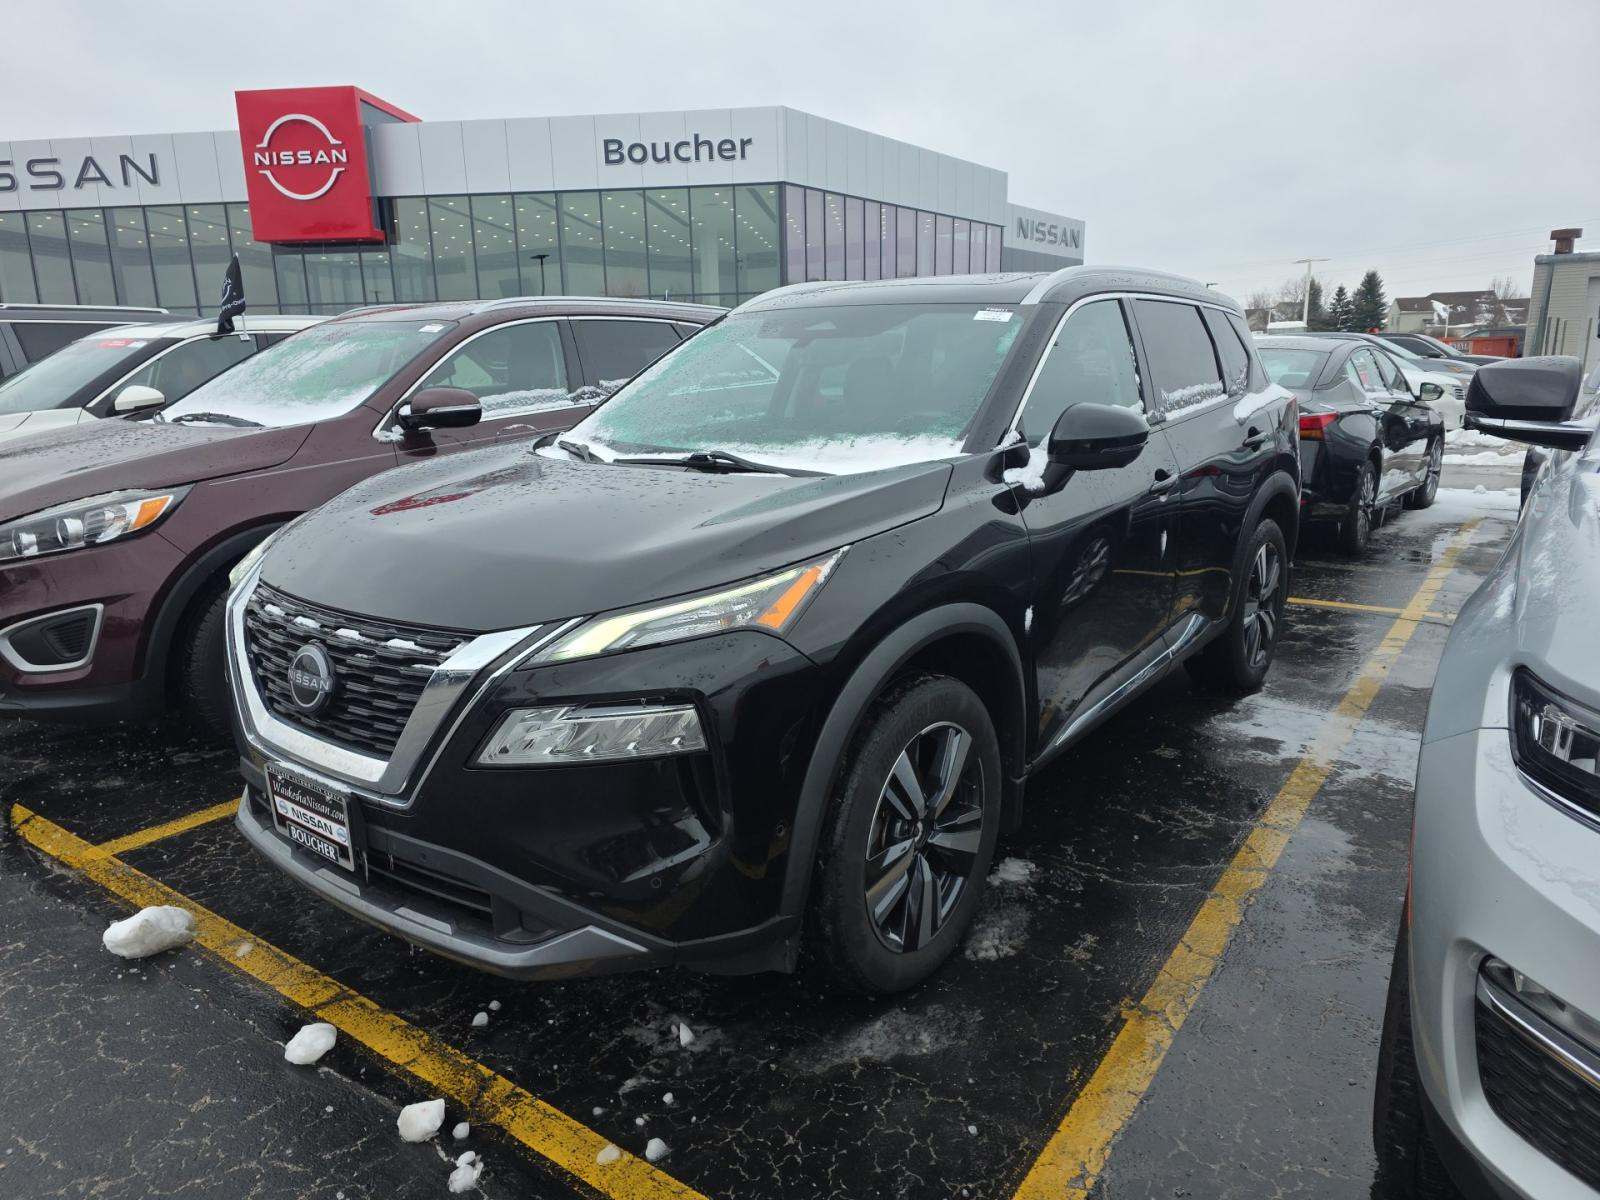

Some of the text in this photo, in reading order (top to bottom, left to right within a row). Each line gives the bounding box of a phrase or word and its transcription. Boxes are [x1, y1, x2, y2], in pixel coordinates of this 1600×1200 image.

[254, 149, 348, 166] NISSAN
[603, 133, 752, 166] Boucher
[1017, 217, 1080, 249] NISSAN
[288, 668, 329, 691] NISSAN
[291, 807, 333, 836] NISSAN
[290, 826, 336, 860] BOUCHER
